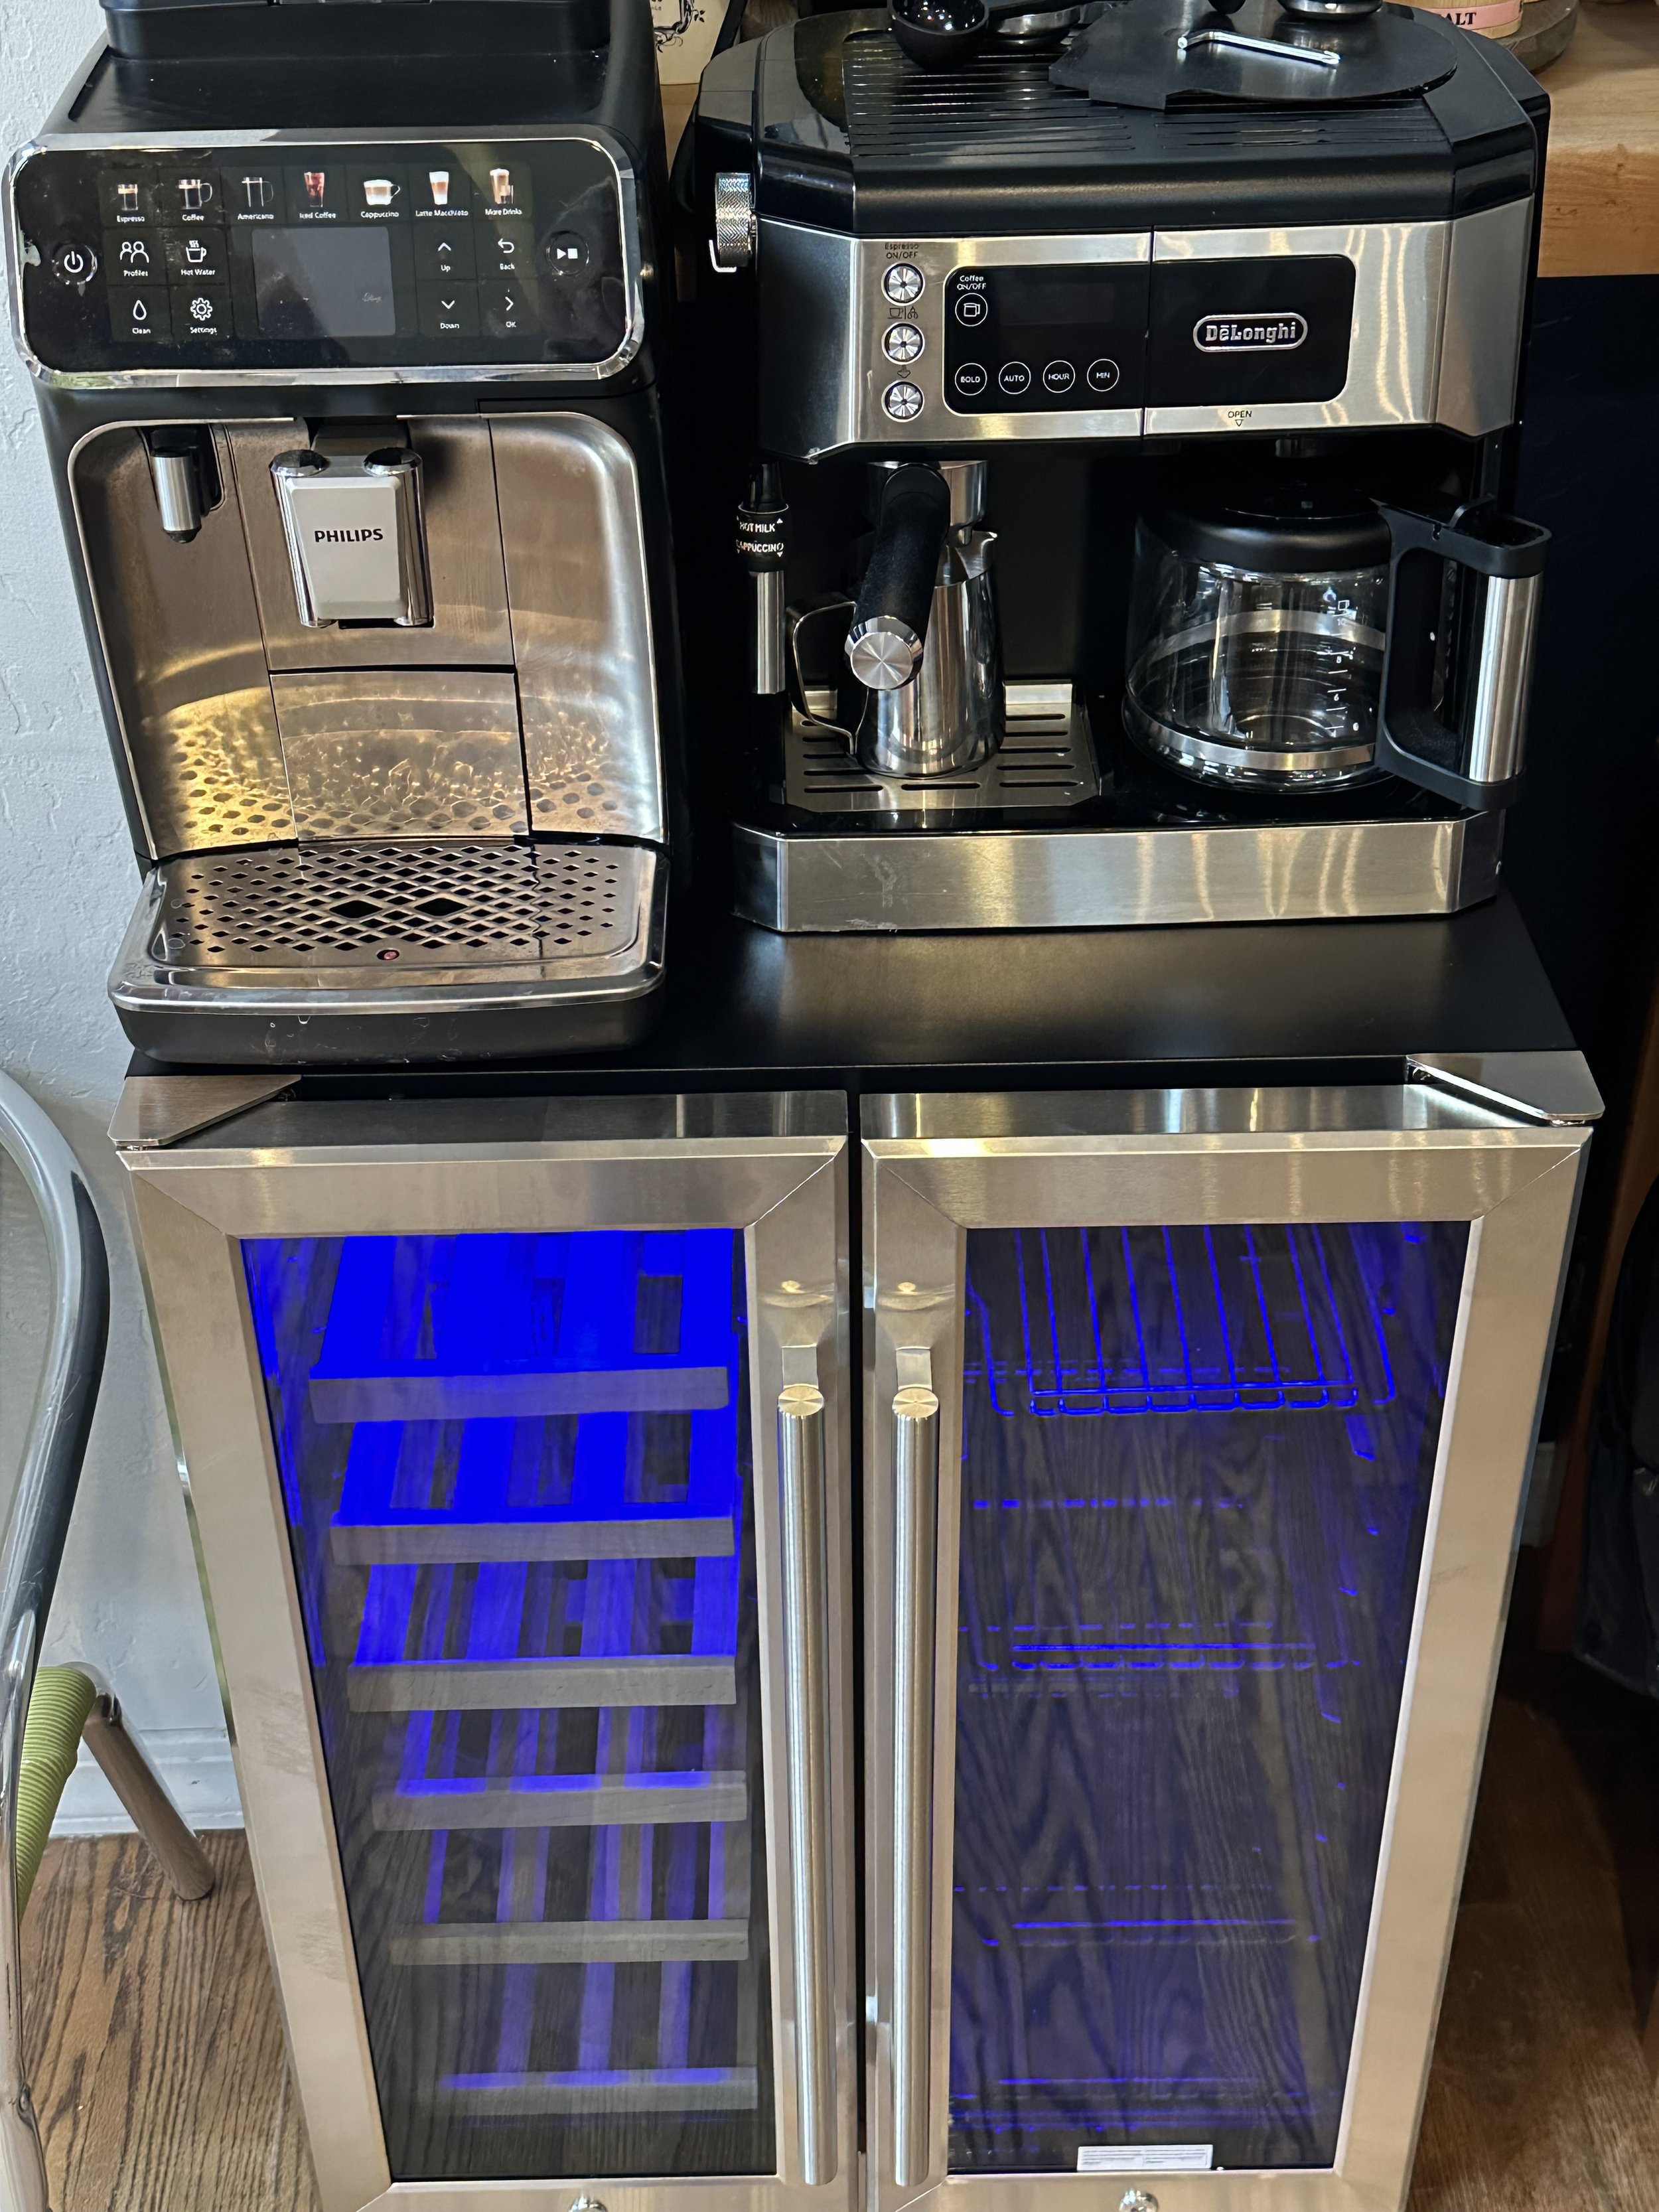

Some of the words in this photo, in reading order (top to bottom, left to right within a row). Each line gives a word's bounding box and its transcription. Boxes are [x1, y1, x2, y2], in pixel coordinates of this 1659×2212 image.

[116, 214, 145, 223] Espresso
[360, 210, 399, 219] Cappuccino
[755, 523, 776, 533] MILK
[314, 528, 384, 543] PHILIPS
